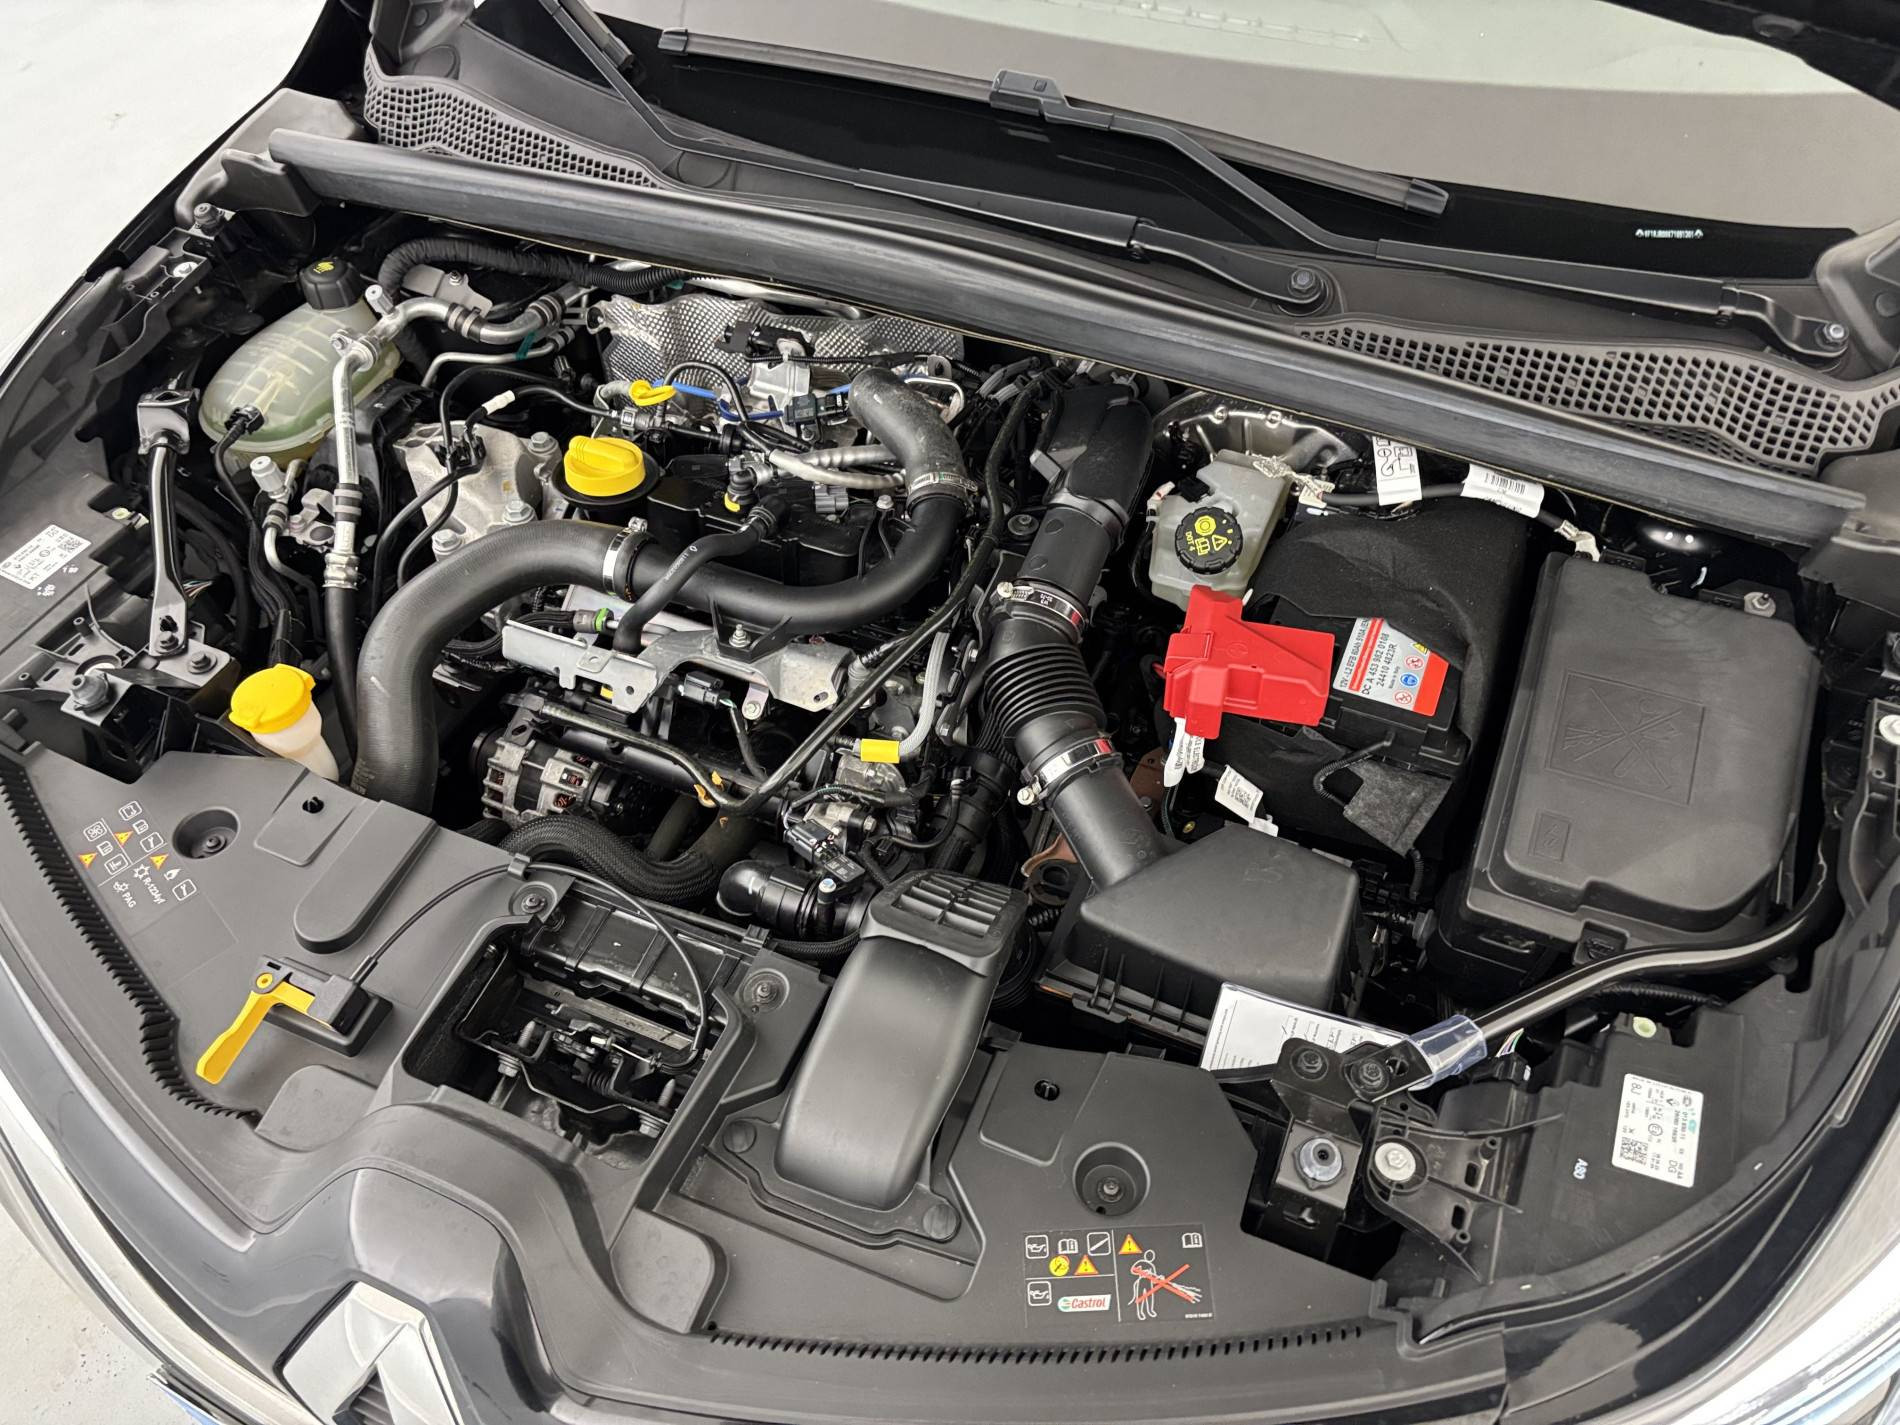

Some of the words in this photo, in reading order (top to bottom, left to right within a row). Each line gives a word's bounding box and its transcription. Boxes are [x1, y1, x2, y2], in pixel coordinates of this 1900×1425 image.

[1185, 531, 1195, 545] DOT
[1361, 684, 1372, 695] DC
[1368, 662, 1379, 676] 453
[1376, 665, 1390, 687] 24410
[122, 891, 137, 908] PAG
[142, 876, 166, 905] R-1234yf
[1072, 1298, 1106, 1308] Castrol
